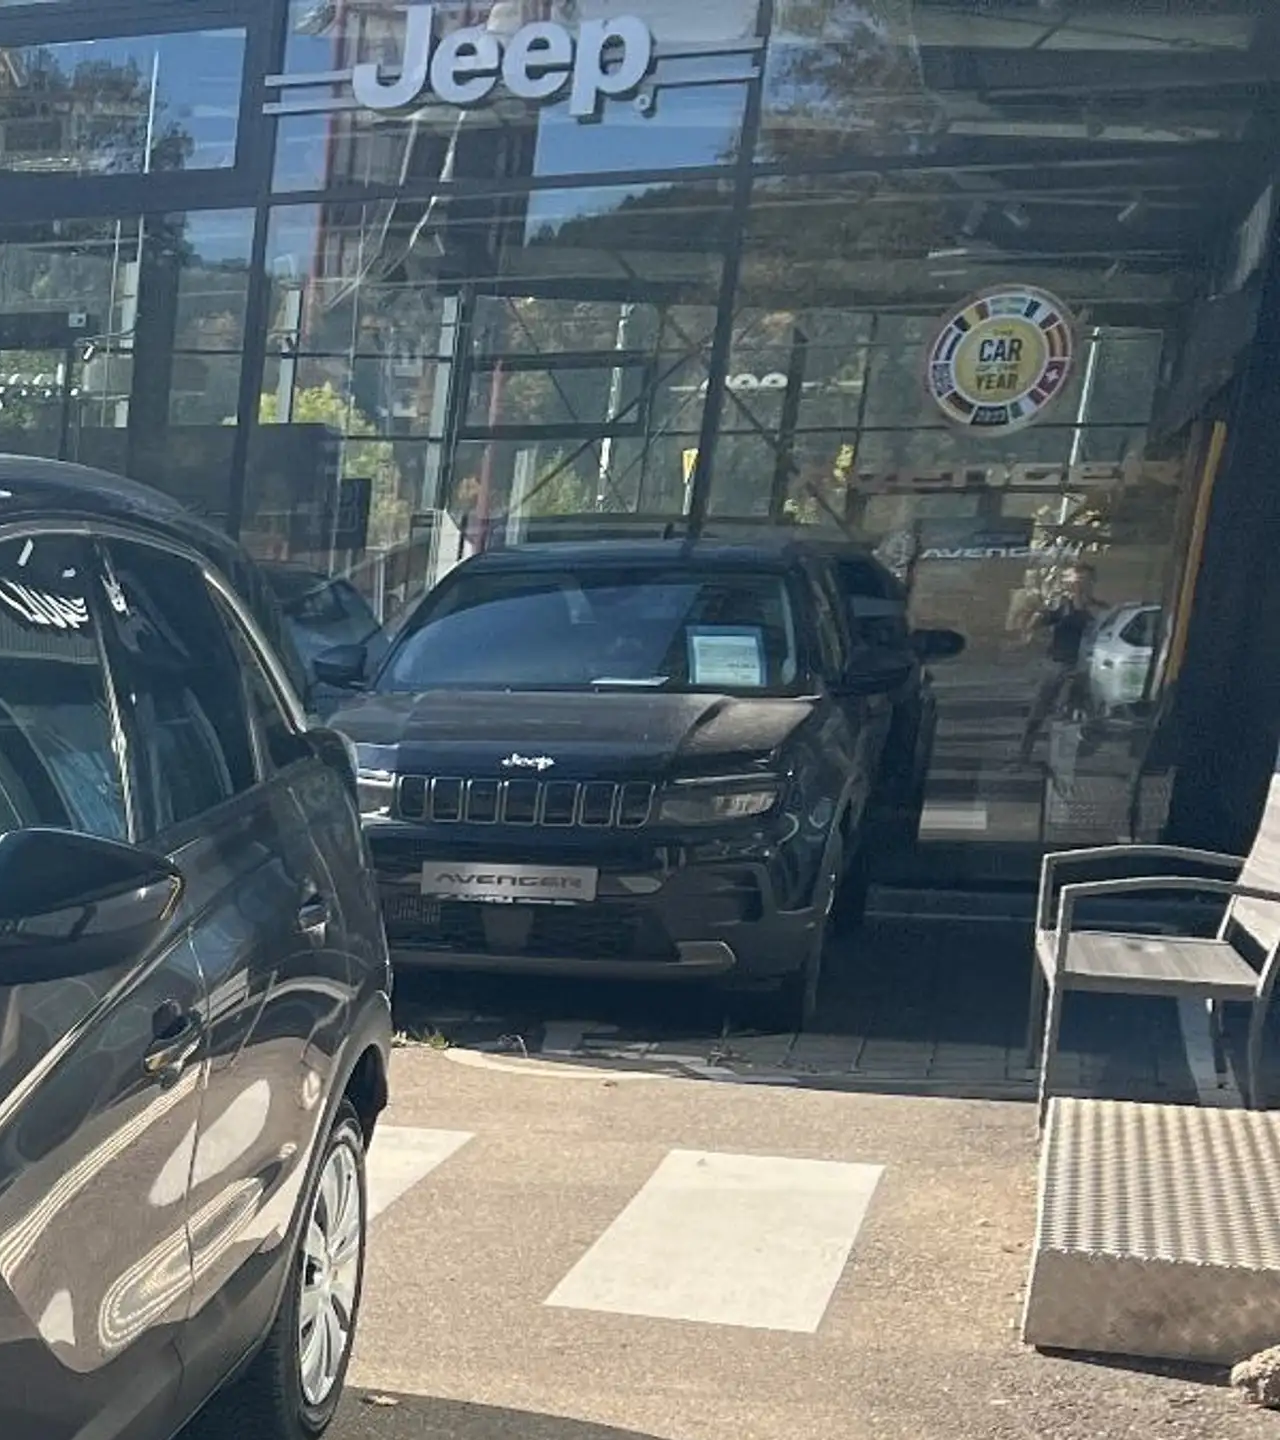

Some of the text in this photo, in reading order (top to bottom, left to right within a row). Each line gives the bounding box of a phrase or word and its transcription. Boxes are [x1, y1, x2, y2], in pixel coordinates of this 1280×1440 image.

[352, 4, 651, 116] Jeep
[979, 338, 1023, 362] CAR
[975, 374, 1019, 391] YEAR
[436, 873, 582, 889] AVENGER
